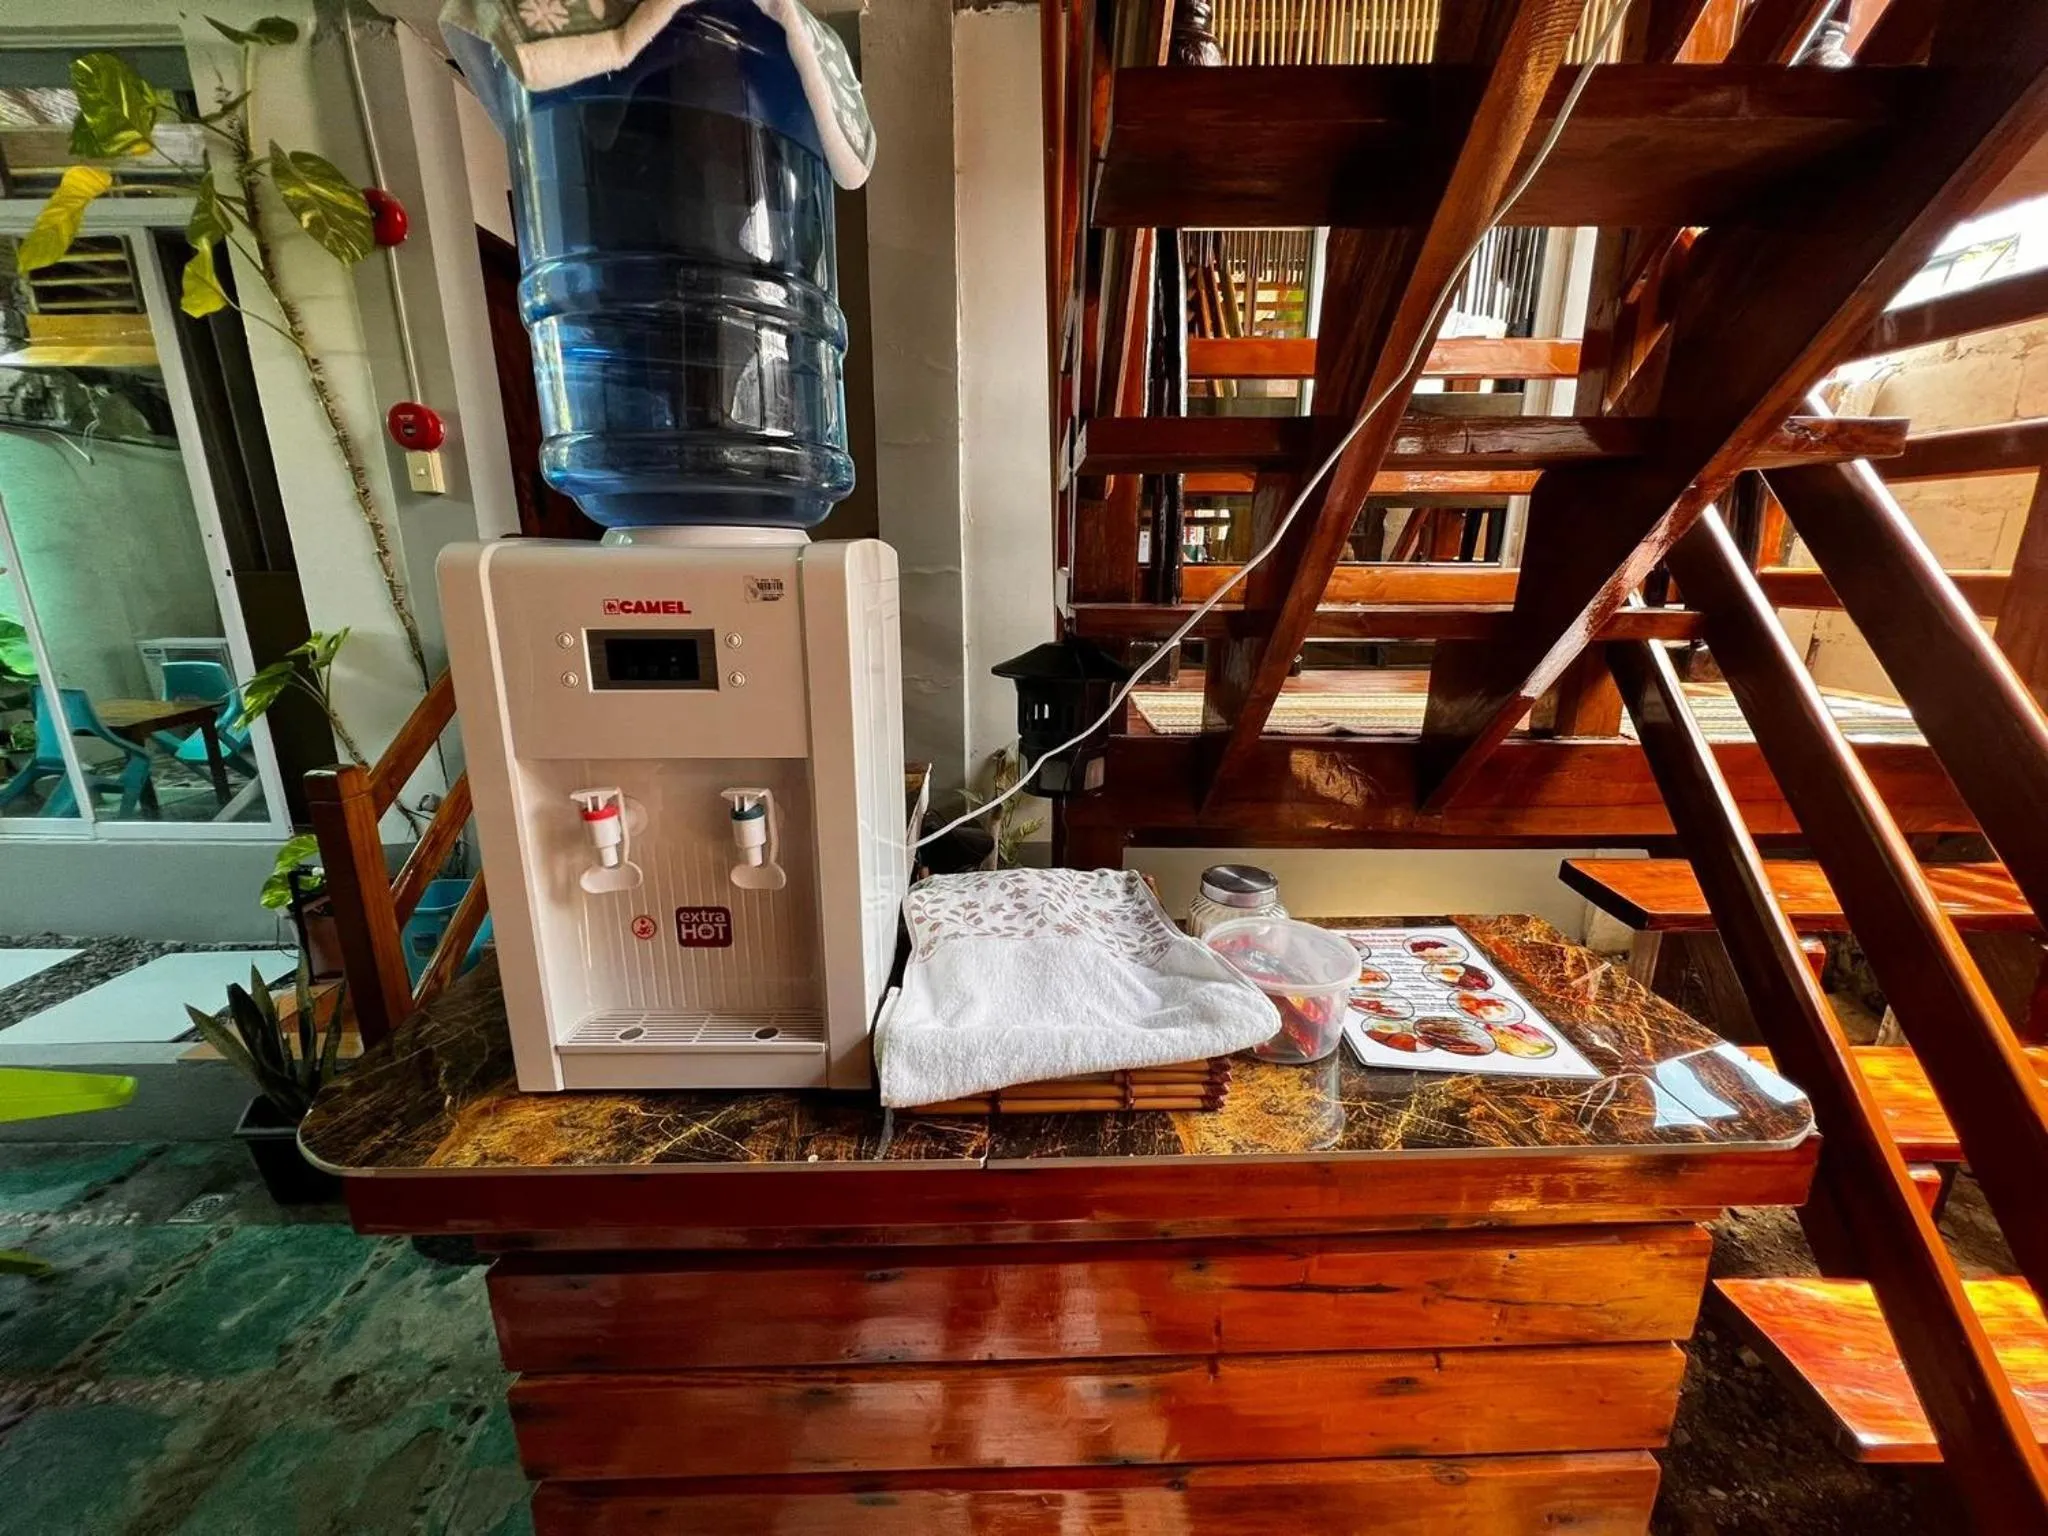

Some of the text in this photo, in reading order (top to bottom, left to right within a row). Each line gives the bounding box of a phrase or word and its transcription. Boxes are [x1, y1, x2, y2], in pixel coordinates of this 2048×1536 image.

[619, 600, 691, 614] CAMEL
[679, 909, 726, 923] extra
[681, 923, 728, 940] HOT
